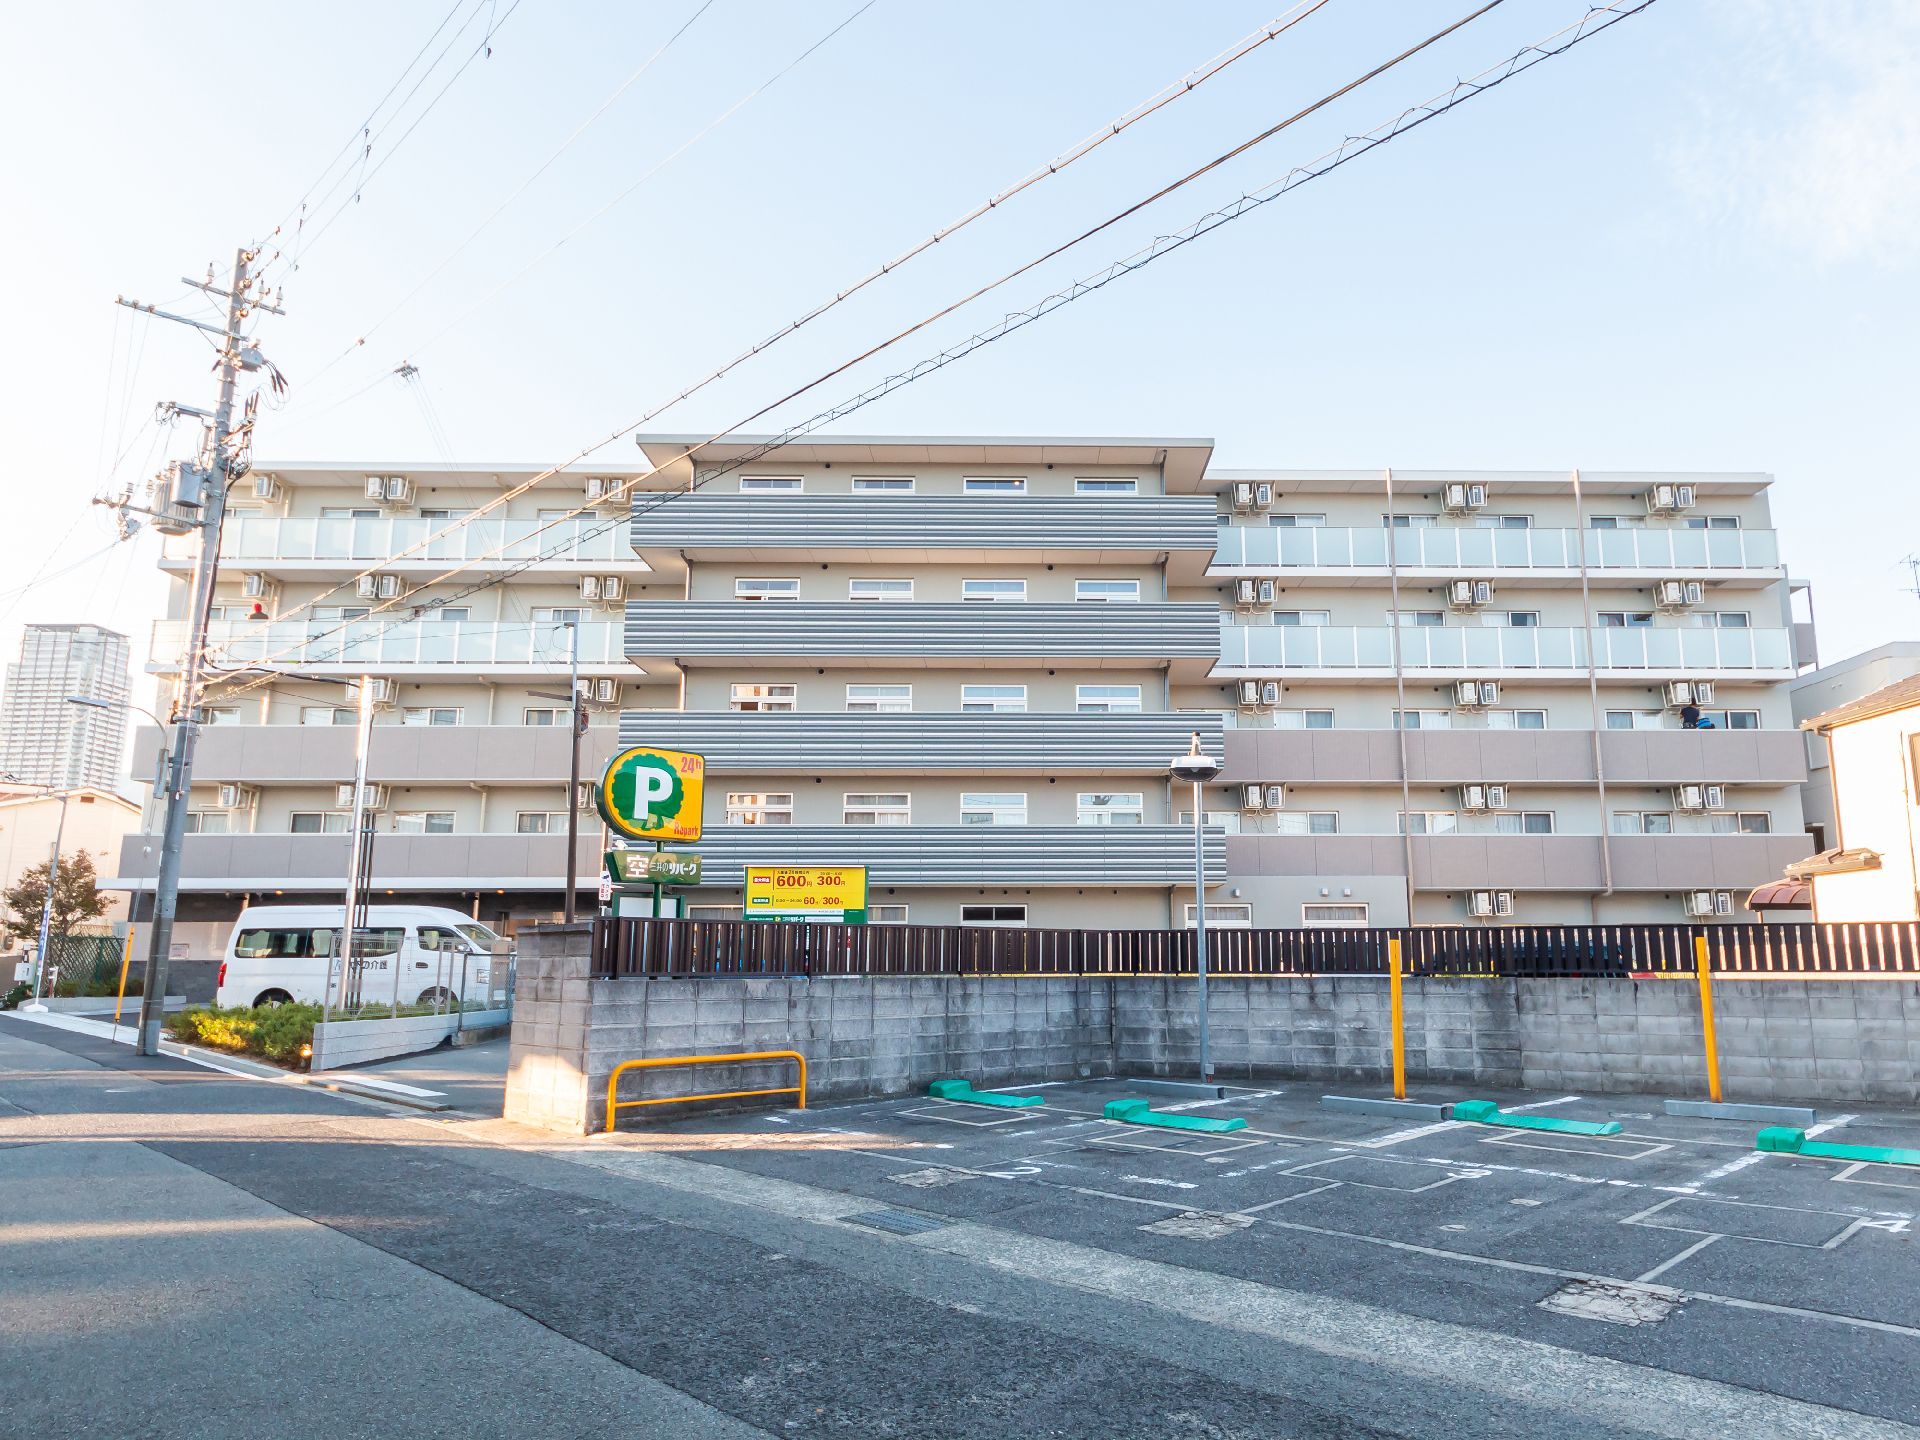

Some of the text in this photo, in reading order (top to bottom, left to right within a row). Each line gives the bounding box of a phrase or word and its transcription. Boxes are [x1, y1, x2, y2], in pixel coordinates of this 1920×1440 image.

[681, 756, 702, 774] 24h
[633, 765, 674, 820] P
[674, 822, 699, 836] Repark
[626, 854, 697, 878] 空 三井のリパーク
